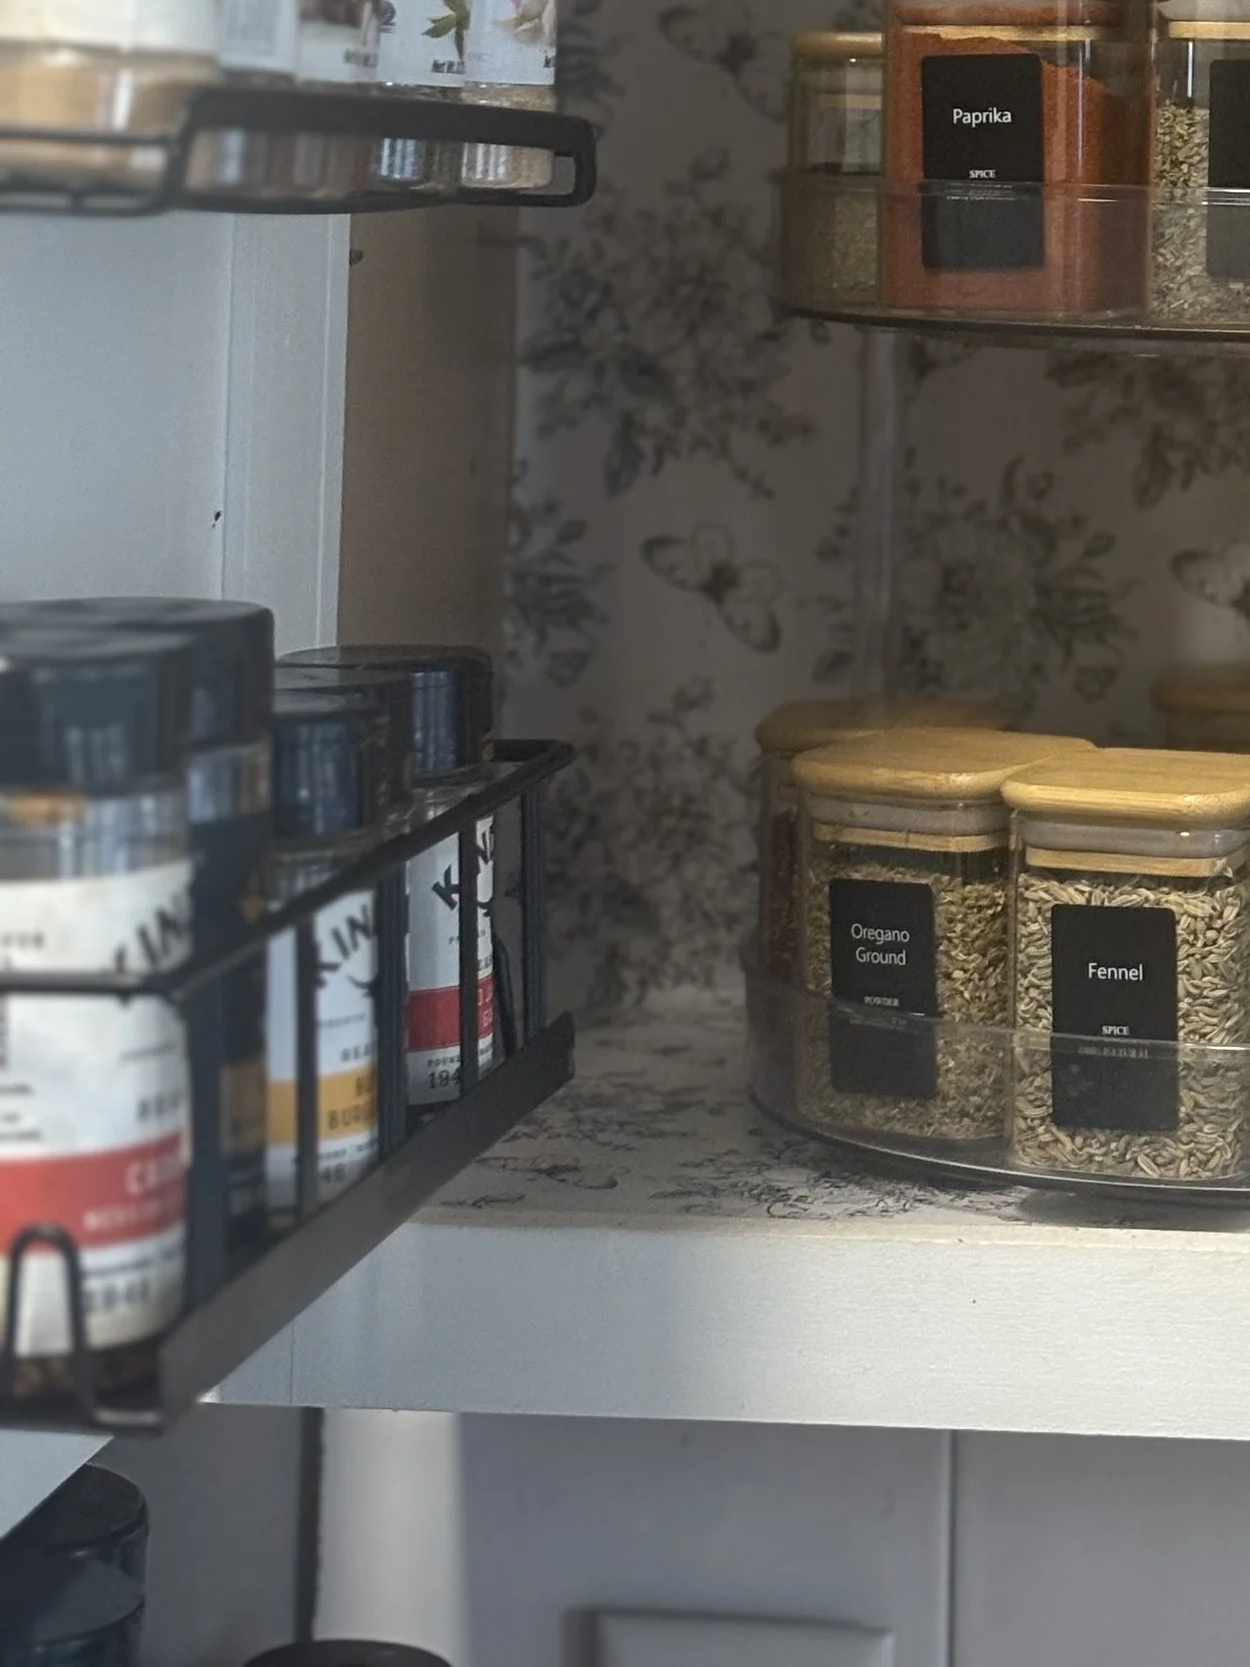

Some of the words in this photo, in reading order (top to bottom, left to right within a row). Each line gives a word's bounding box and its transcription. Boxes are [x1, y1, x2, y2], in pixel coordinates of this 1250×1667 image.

[953, 107, 1012, 128] Paprika
[969, 169, 996, 179] SPICE
[851, 923, 909, 945] Oregano
[855, 947, 906, 965] Ground
[1088, 962, 1143, 981] Fennel
[1102, 1025, 1130, 1035] SPICE
